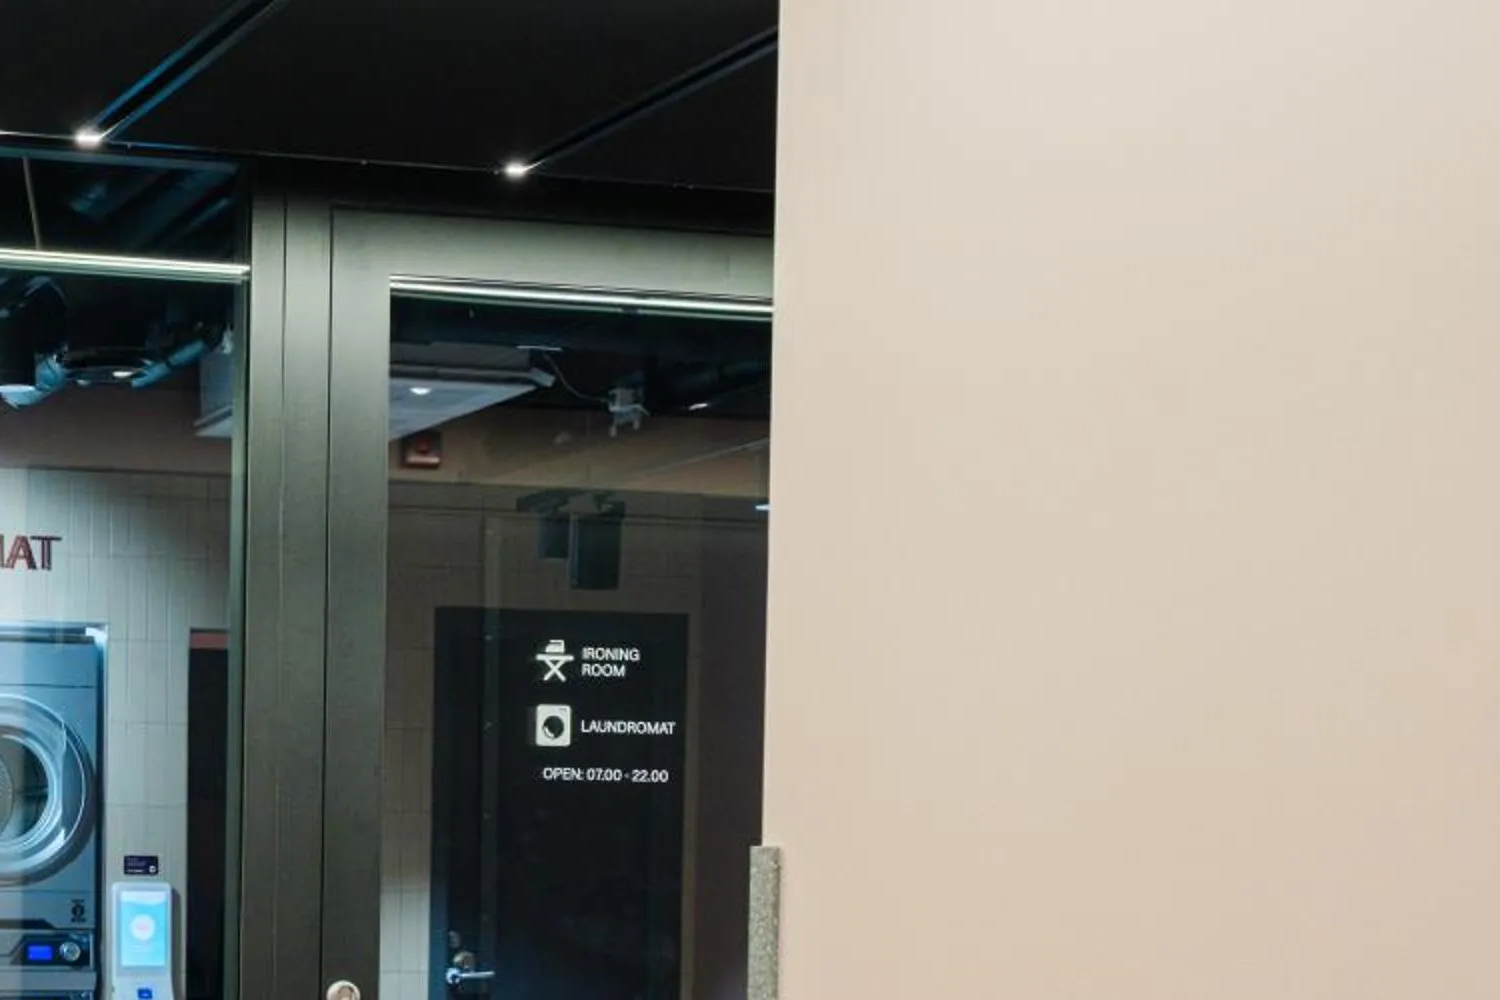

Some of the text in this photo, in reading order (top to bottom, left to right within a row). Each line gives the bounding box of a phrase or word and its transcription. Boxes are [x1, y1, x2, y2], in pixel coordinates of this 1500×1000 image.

[582, 647, 640, 661] IRONING
[581, 663, 626, 676] ROOM
[581, 720, 676, 734] LAUNDROMAT
[543, 767, 583, 780] OPEN:
[586, 768, 622, 781] 07.00
[631, 769, 669, 783] 22.00
